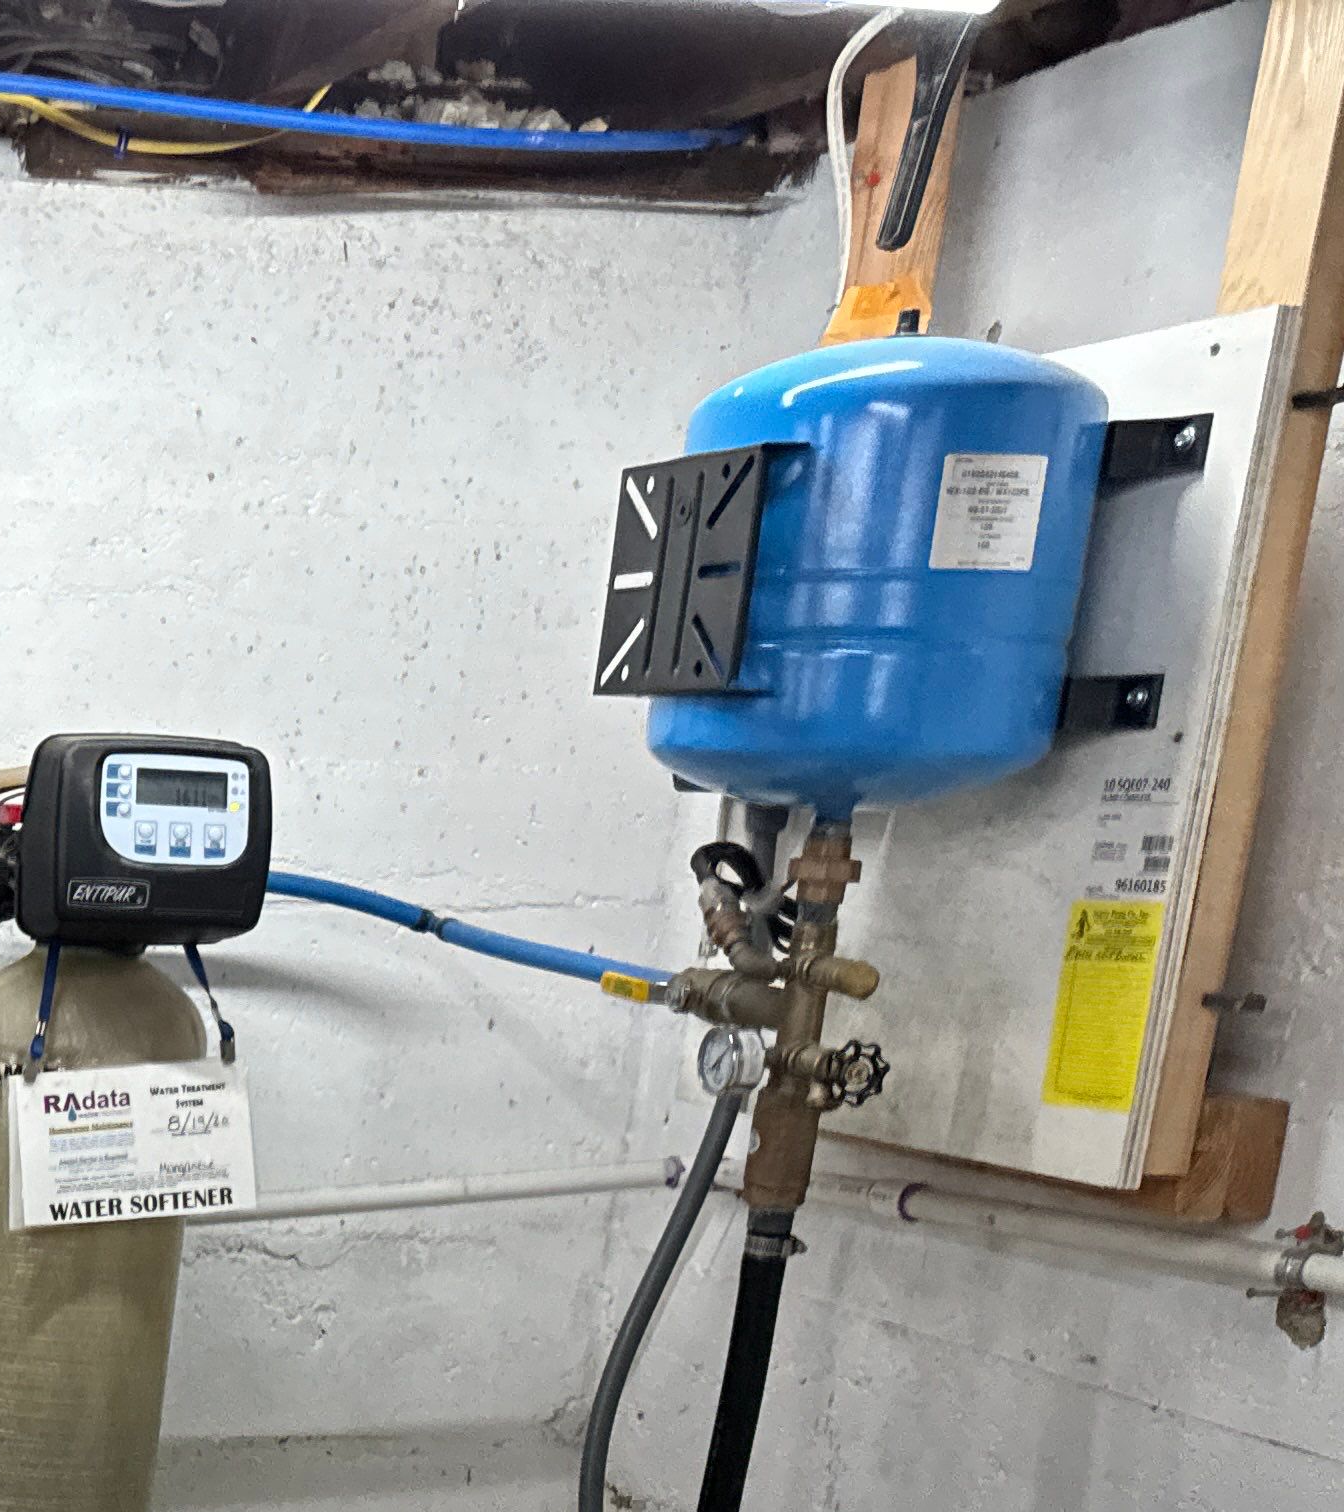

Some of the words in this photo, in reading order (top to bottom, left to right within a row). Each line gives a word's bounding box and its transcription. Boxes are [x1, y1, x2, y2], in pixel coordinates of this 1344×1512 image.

[150, 1086, 179, 1095] WATER
[181, 1082, 226, 1093] TREATMENT
[44, 1089, 130, 1114] RAdata
[49, 1197, 122, 1221] WATER
[130, 1187, 233, 1214] SOFTENER
